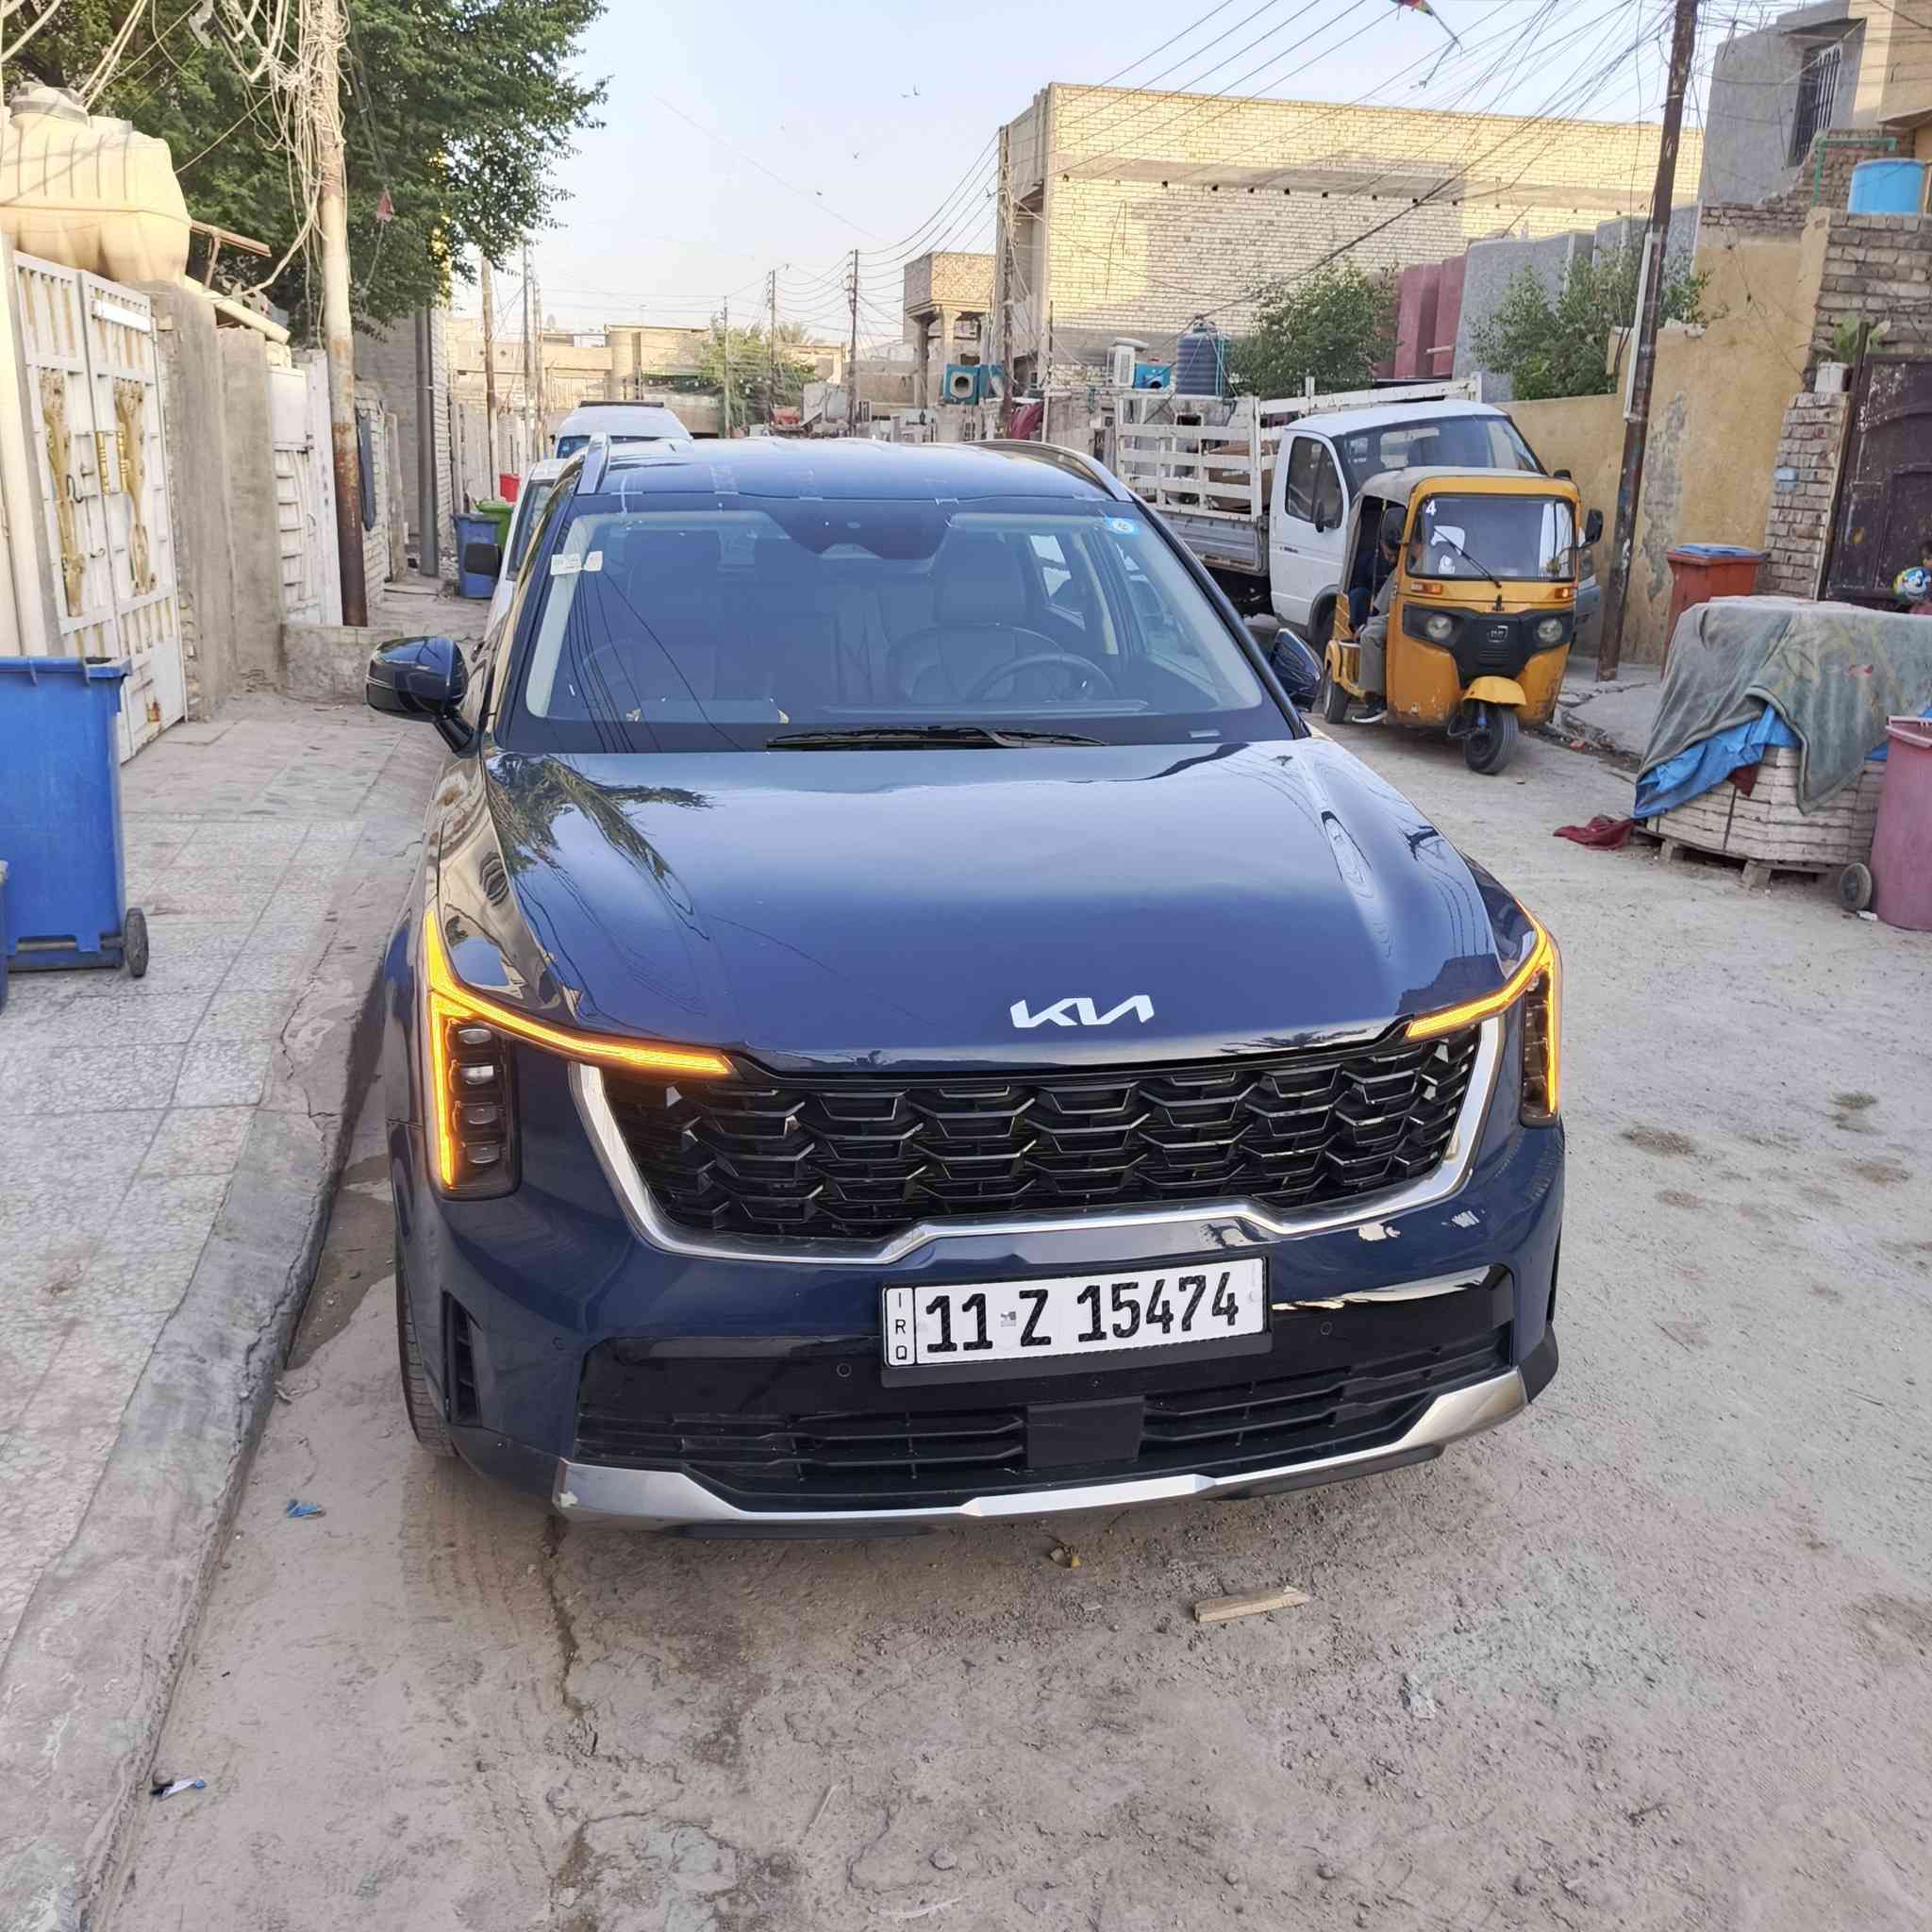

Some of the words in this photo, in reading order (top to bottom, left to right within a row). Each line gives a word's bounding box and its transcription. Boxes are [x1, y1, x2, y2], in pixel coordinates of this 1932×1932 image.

[1425, 499, 1437, 516] 4
[1009, 994, 1155, 1028] KIA
[894, 1291, 908, 1360] IRQ
[925, 1293, 993, 1354] 11
[1019, 1289, 1052, 1348] Z
[1076, 1272, 1240, 1343] 15474
